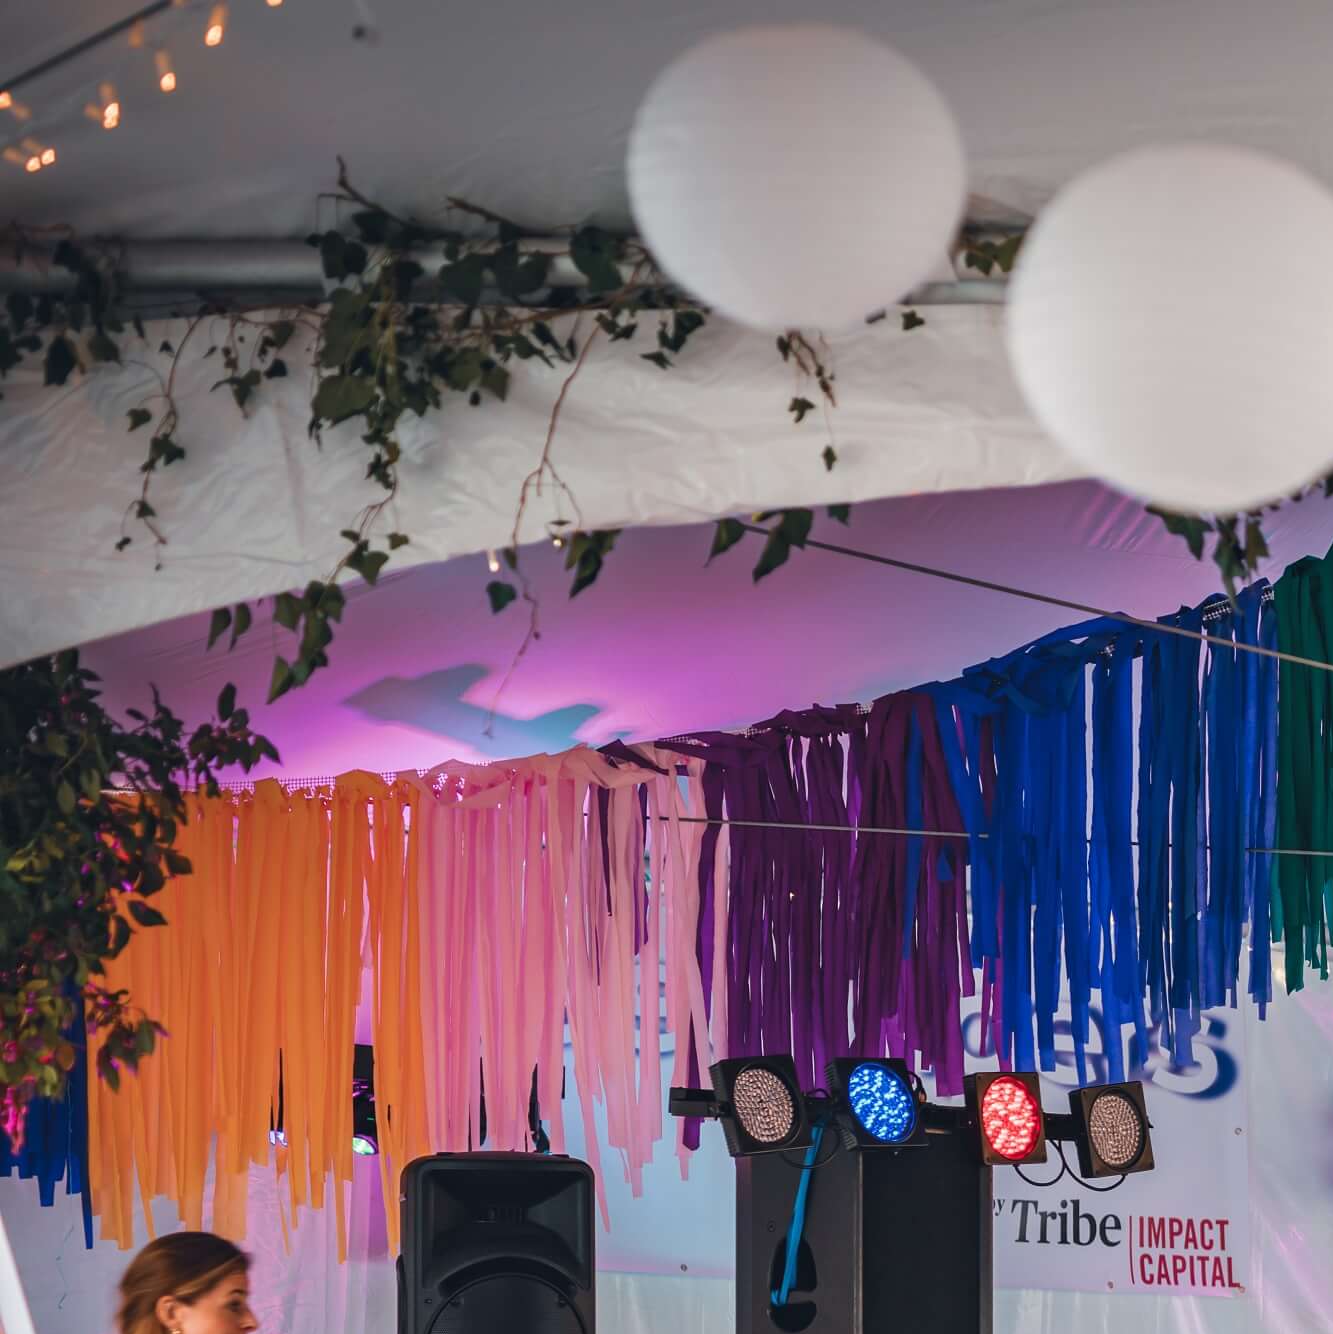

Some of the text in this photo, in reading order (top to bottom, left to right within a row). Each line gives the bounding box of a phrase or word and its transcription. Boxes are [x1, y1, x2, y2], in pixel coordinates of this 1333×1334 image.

[1011, 1199, 1122, 1248] Tribe
[1138, 1215, 1230, 1252] IMPACT
[1139, 1254, 1241, 1289] CAPITAL
